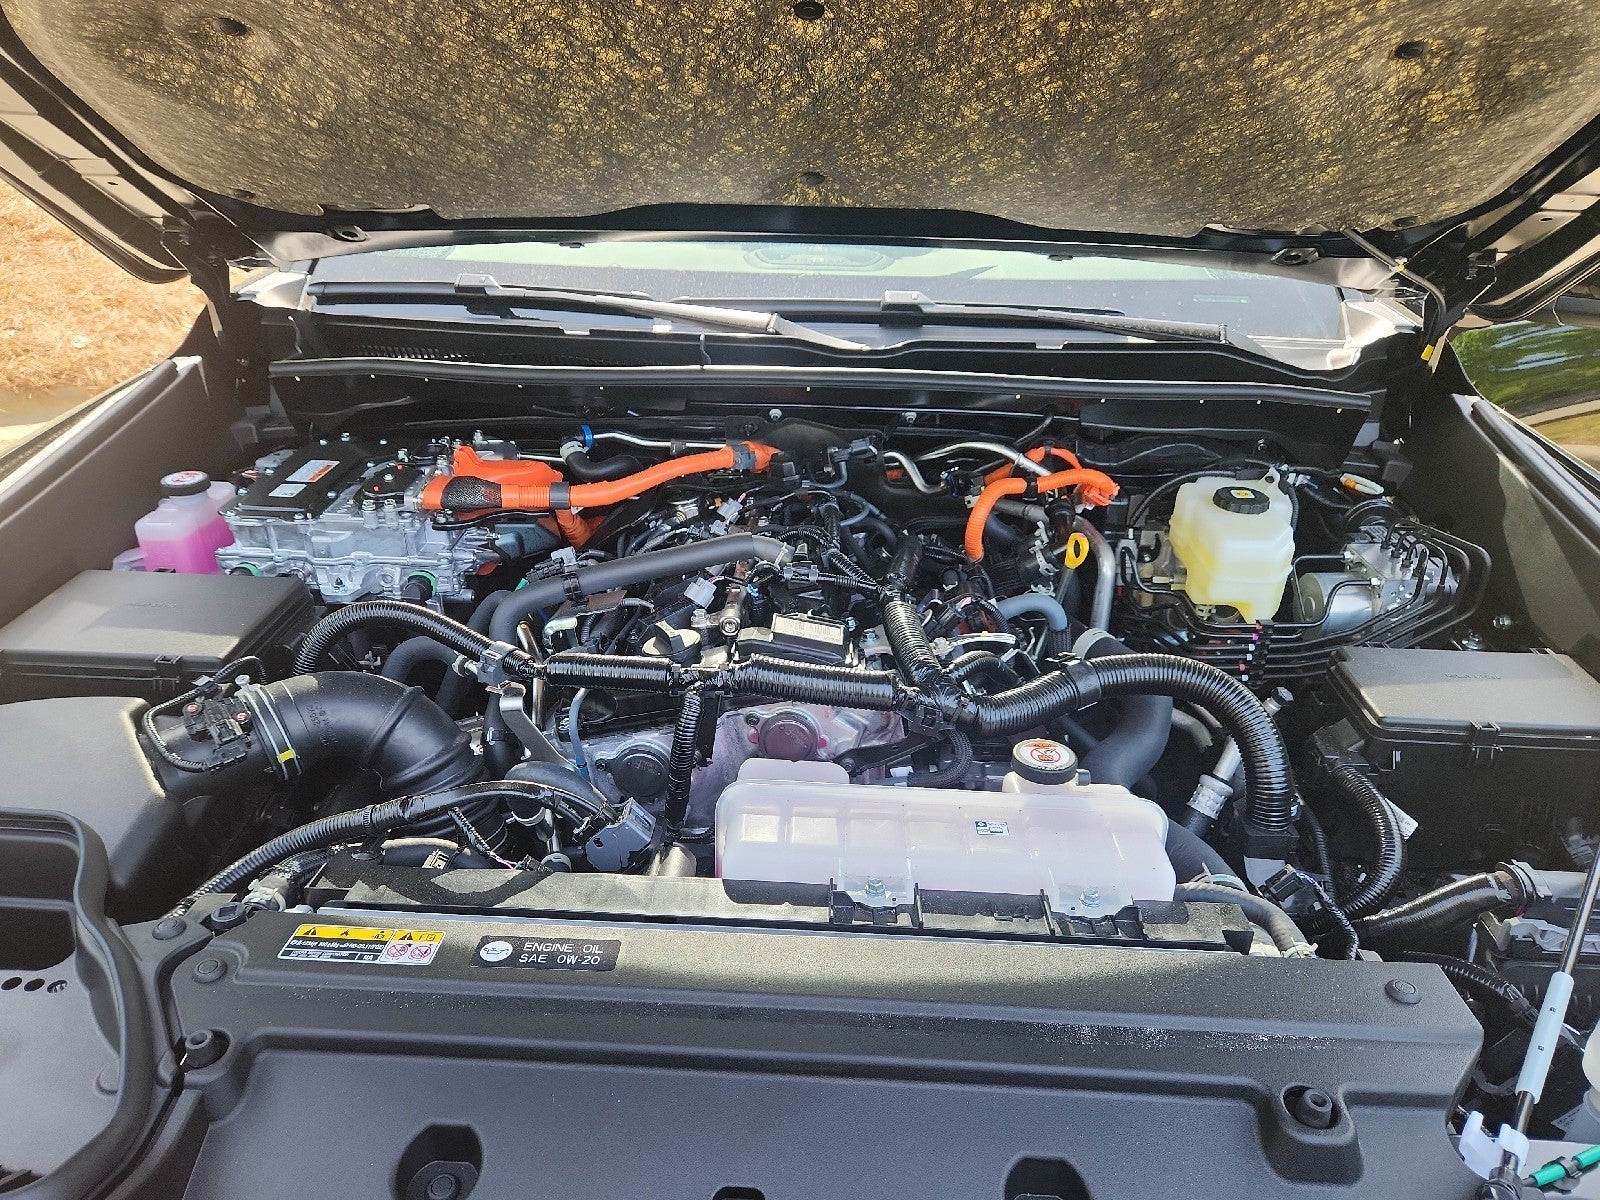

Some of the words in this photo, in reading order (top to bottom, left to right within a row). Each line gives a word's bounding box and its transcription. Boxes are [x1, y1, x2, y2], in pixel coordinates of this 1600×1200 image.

[523, 942, 574, 953] ENGINE
[582, 944, 604, 954] OIL
[519, 953, 548, 964] SAE
[556, 954, 601, 965] 0W-20
